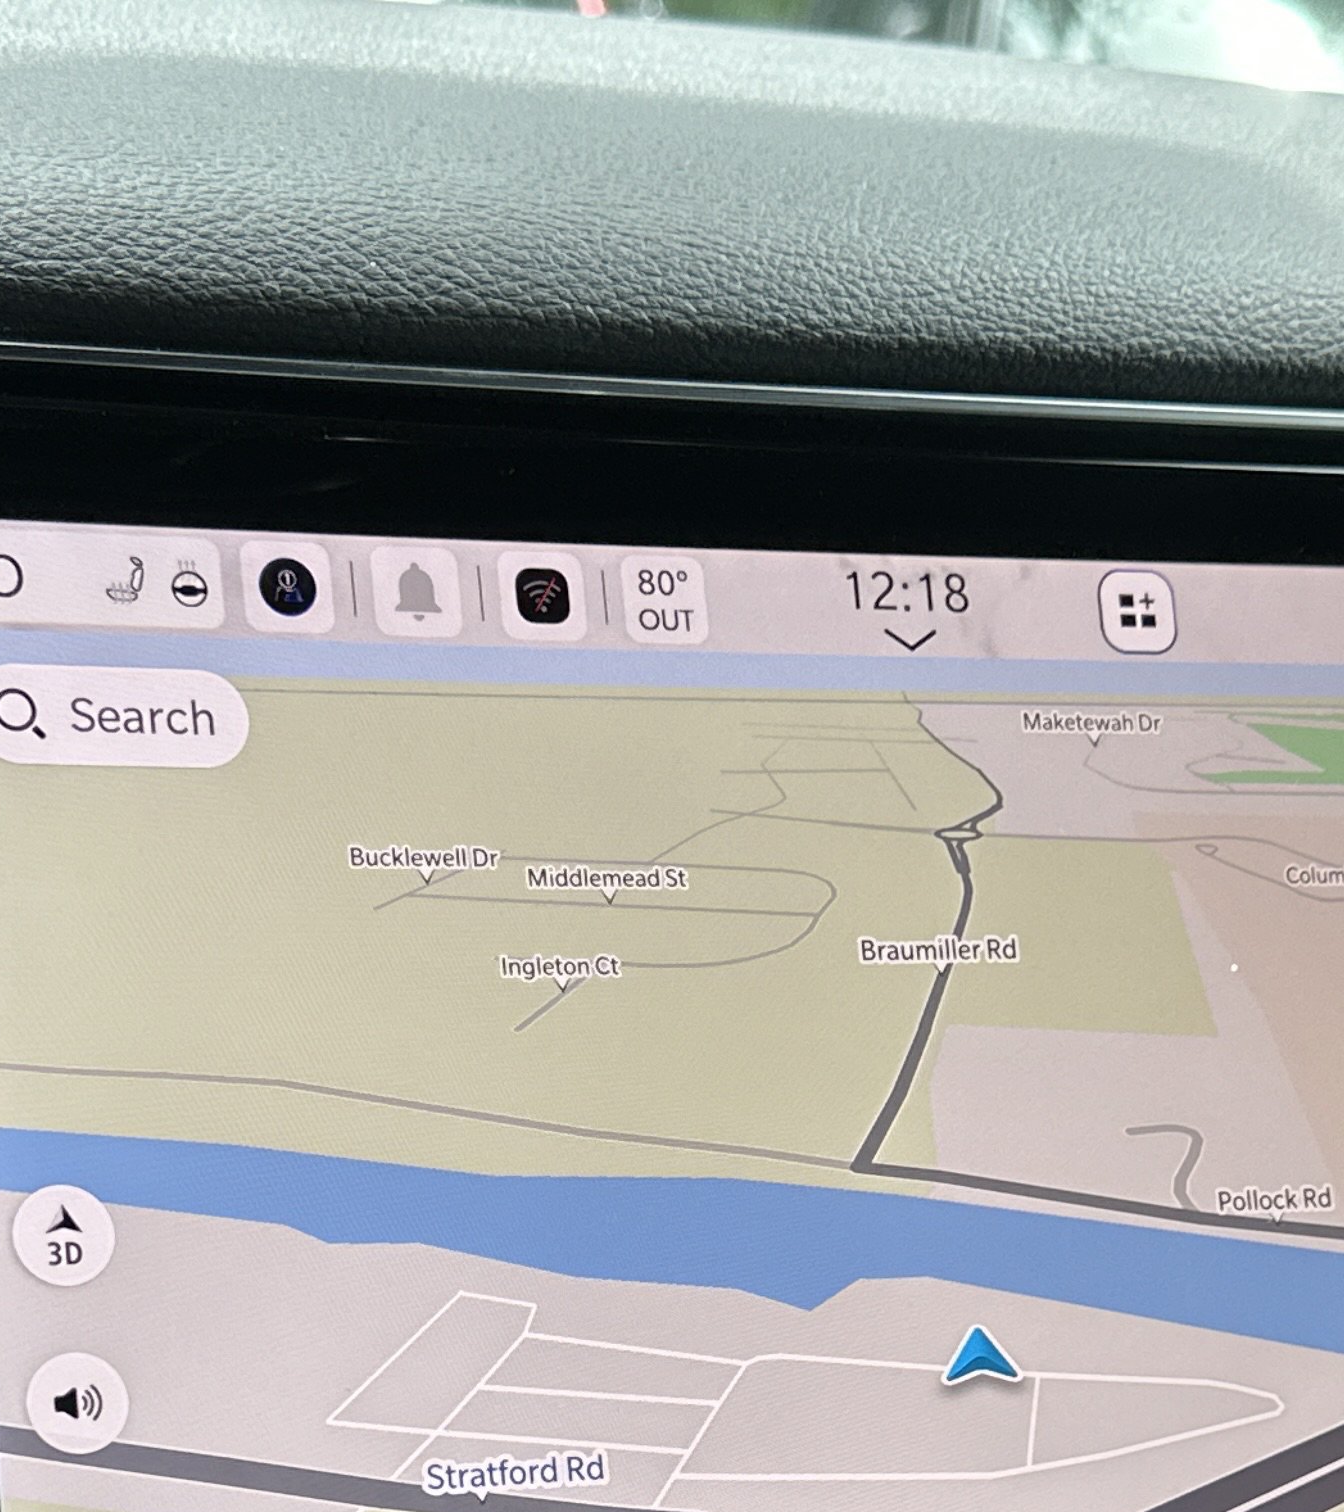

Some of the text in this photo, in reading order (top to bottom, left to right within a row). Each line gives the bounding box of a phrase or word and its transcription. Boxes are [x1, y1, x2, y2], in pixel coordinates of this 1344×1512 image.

[638, 569, 688, 597] 80°
[846, 571, 970, 613] 12:18
[639, 609, 694, 632] OUT
[71, 698, 215, 737] Search
[1023, 712, 1161, 732] Maketewah Dr
[350, 847, 498, 868] Bucklewell Dr
[528, 868, 687, 889] Middlemead St
[861, 938, 1017, 962] Braumiller Rd
[501, 956, 619, 981] Ingleton Ct
[1218, 1188, 1331, 1213] Pollock Rd
[48, 1242, 83, 1266] 3D
[426, 1456, 604, 1491] Stratford Rd
